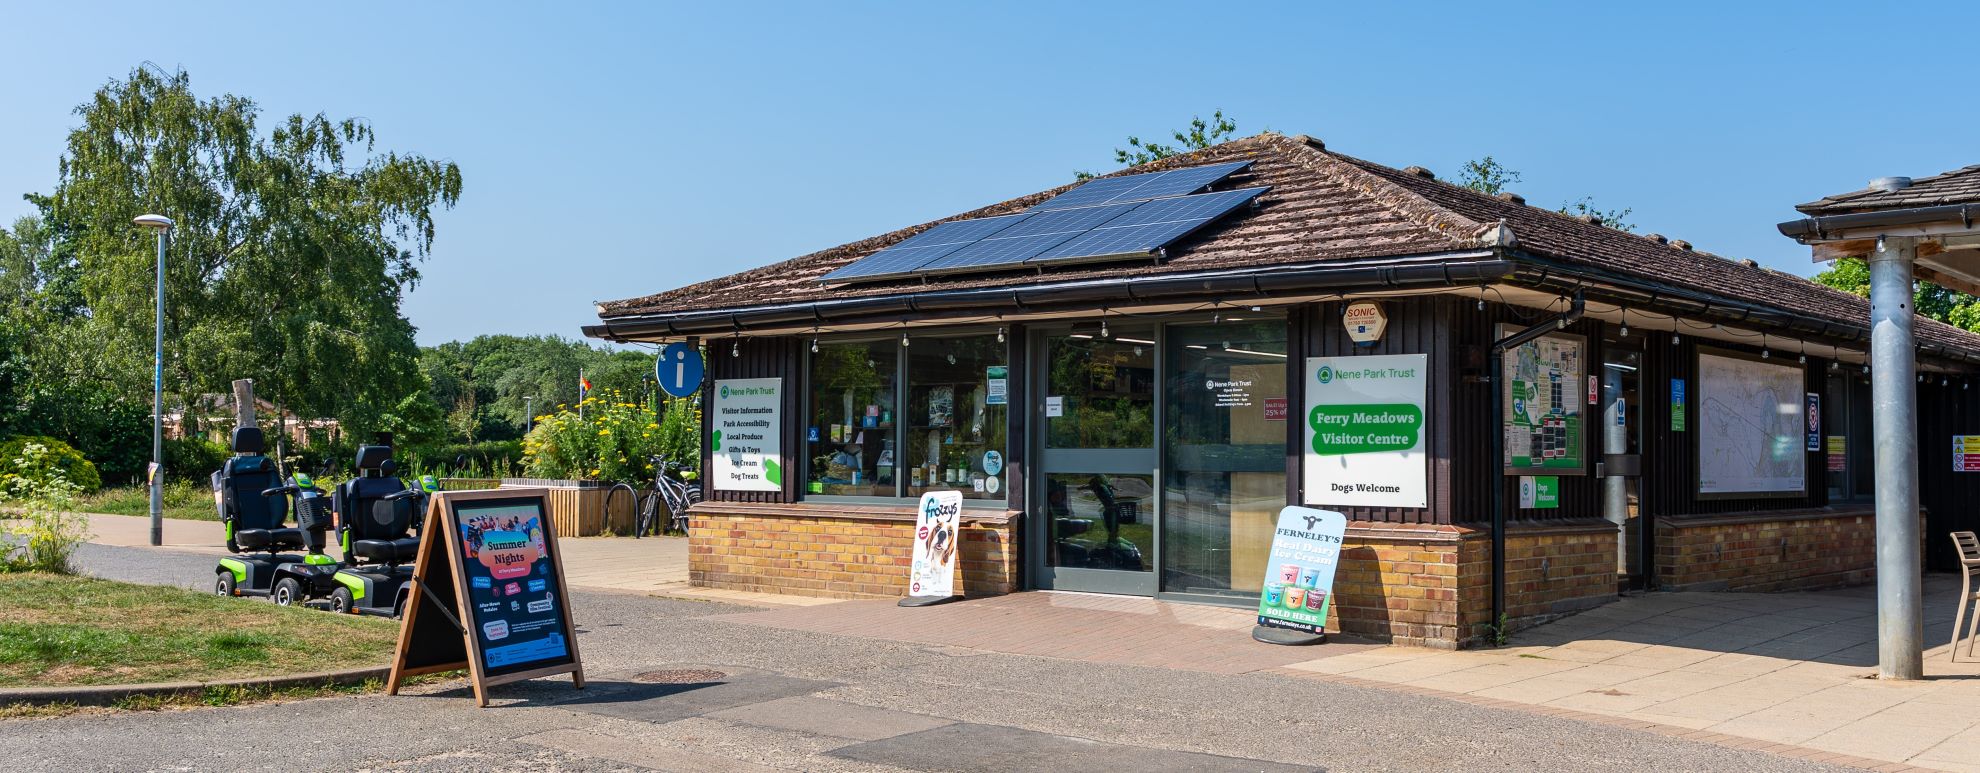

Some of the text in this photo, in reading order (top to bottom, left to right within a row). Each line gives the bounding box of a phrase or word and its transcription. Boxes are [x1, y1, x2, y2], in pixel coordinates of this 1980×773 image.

[1348, 308, 1375, 317] SONIC
[1336, 368, 1415, 379] Nene Park Trust
[737, 420, 769, 428] Accessibility
[1317, 412, 1414, 426] Ferry Meadows
[1322, 433, 1409, 444] Visitor Centre
[1331, 483, 1400, 493] Dogs Welcome
[1277, 528, 1340, 543] FERNELEY'S
[488, 540, 526, 551] Summer
[1275, 539, 1336, 558] Real Dairy
[494, 555, 525, 565] Nights
[1275, 548, 1332, 566] Ice Cream
[1266, 608, 1318, 622] SOLD HERE
[1269, 619, 1312, 630] www.ferneleys.co.uk
